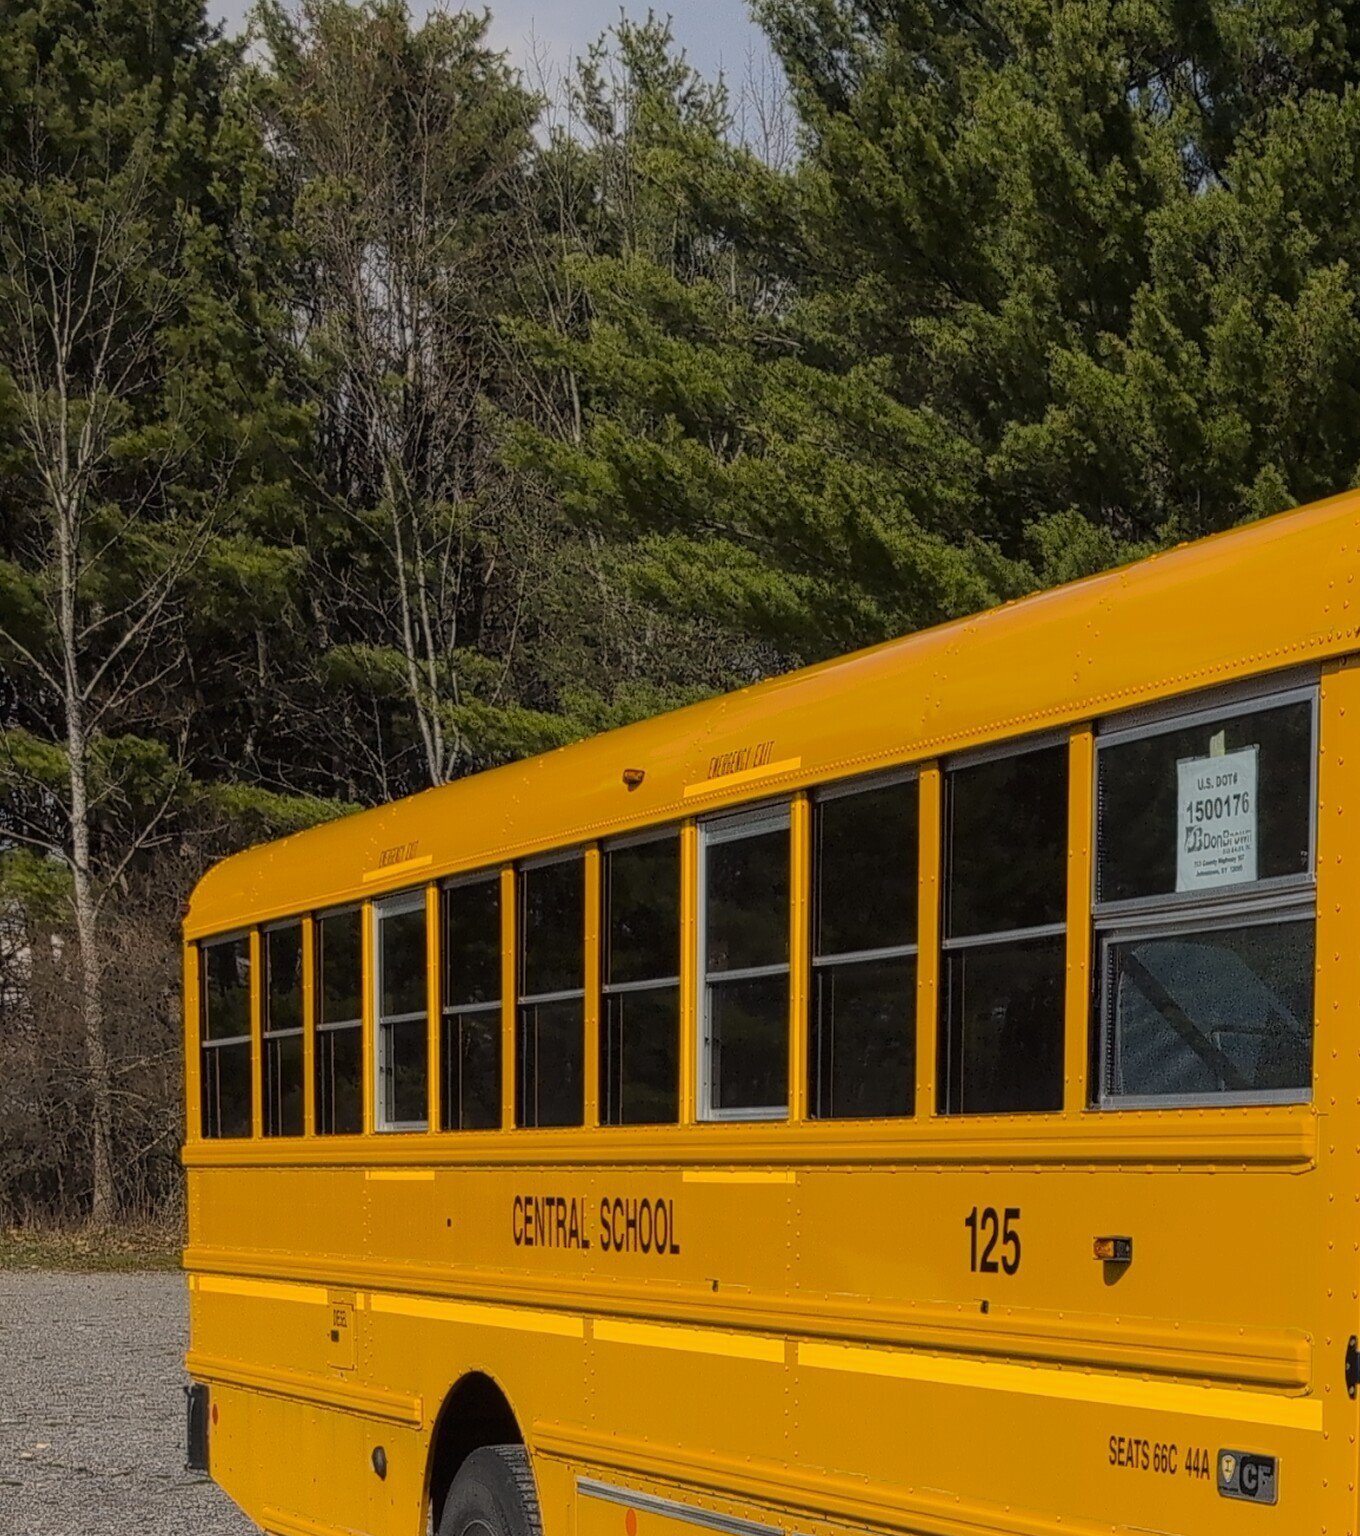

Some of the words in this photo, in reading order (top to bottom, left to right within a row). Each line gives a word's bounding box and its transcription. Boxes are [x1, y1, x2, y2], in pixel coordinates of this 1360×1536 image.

[1197, 777, 1214, 791] U.S.
[1186, 791, 1249, 823] 1500176
[512, 1195, 590, 1249] CENTRAL
[600, 1197, 680, 1255] SCHOOL
[965, 1206, 1021, 1276] 125
[1108, 1435, 1150, 1471] SEATS
[1153, 1442, 1178, 1475] 66C
[1185, 1447, 1211, 1480] 44A
